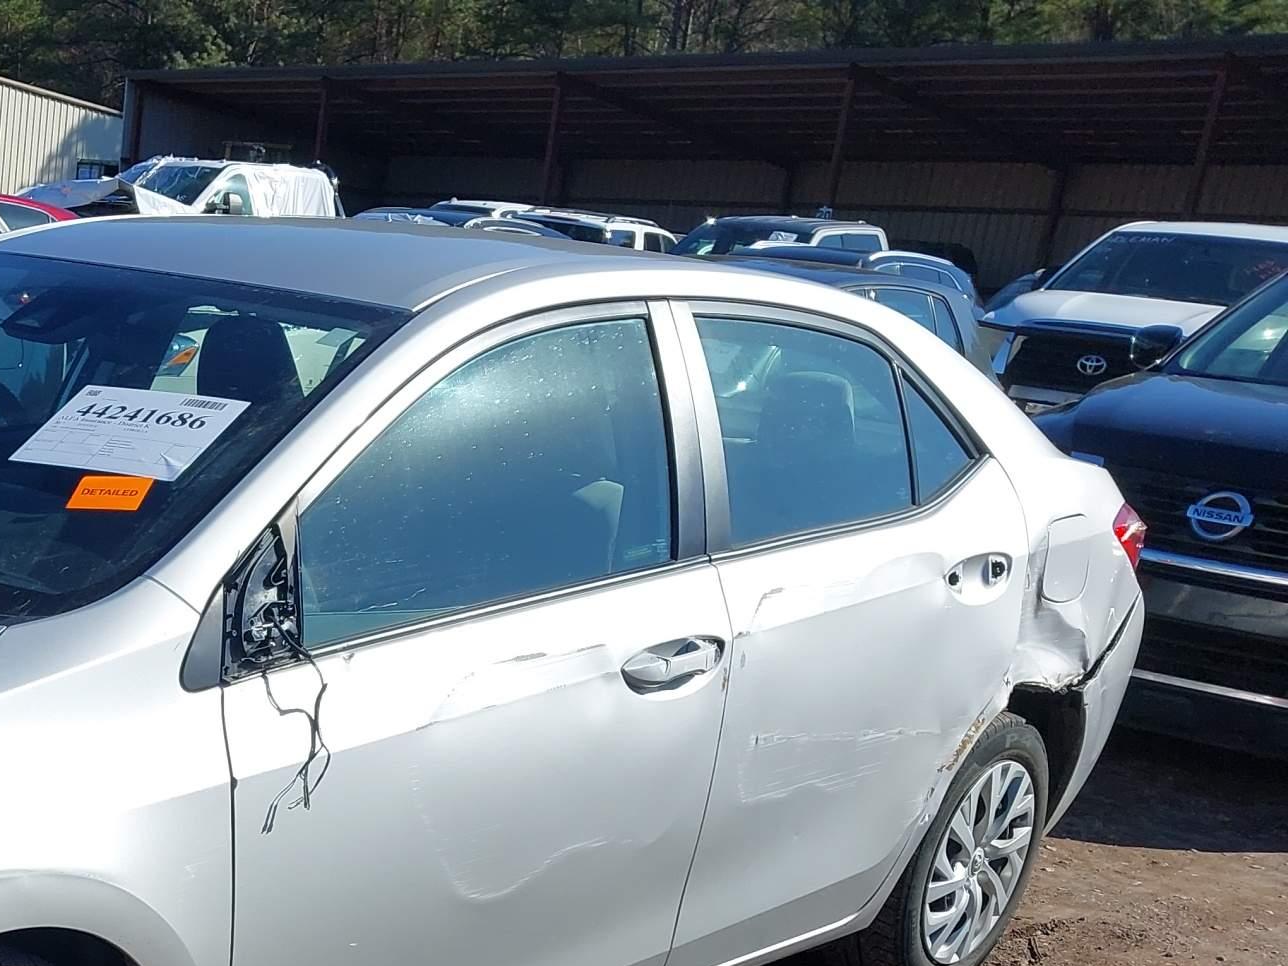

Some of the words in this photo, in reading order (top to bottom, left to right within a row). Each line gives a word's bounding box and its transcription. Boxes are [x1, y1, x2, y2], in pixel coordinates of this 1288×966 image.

[76, 402, 214, 430] 44241686
[80, 487, 139, 498] DETAILED
[1192, 507, 1245, 524] NISSAN
